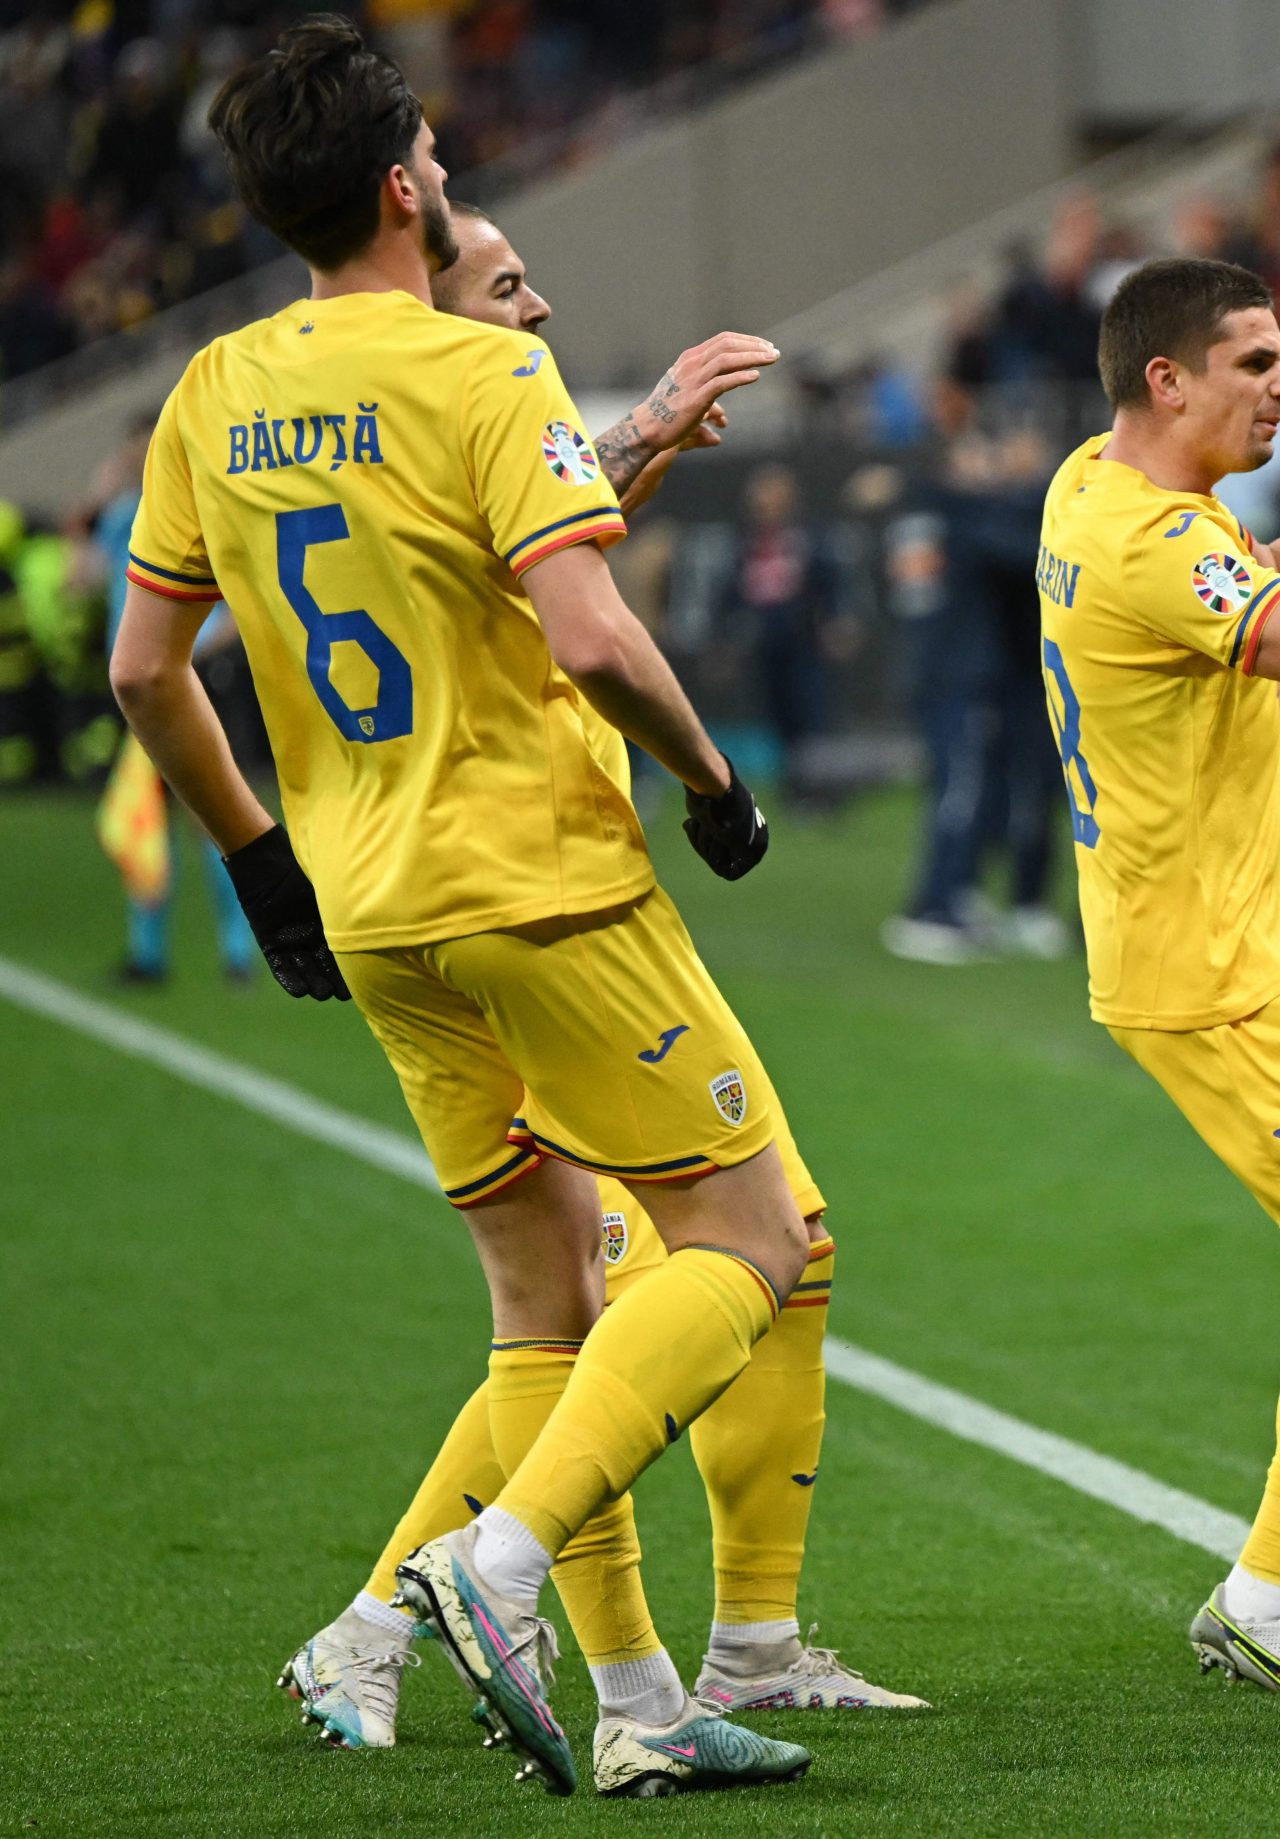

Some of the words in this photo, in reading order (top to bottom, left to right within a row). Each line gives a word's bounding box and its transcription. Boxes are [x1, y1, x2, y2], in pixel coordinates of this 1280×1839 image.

[226, 402, 383, 474] BĂLUȚĂ
[275, 503, 413, 744] 6
[602, 1215, 622, 1223] ÂNIA
